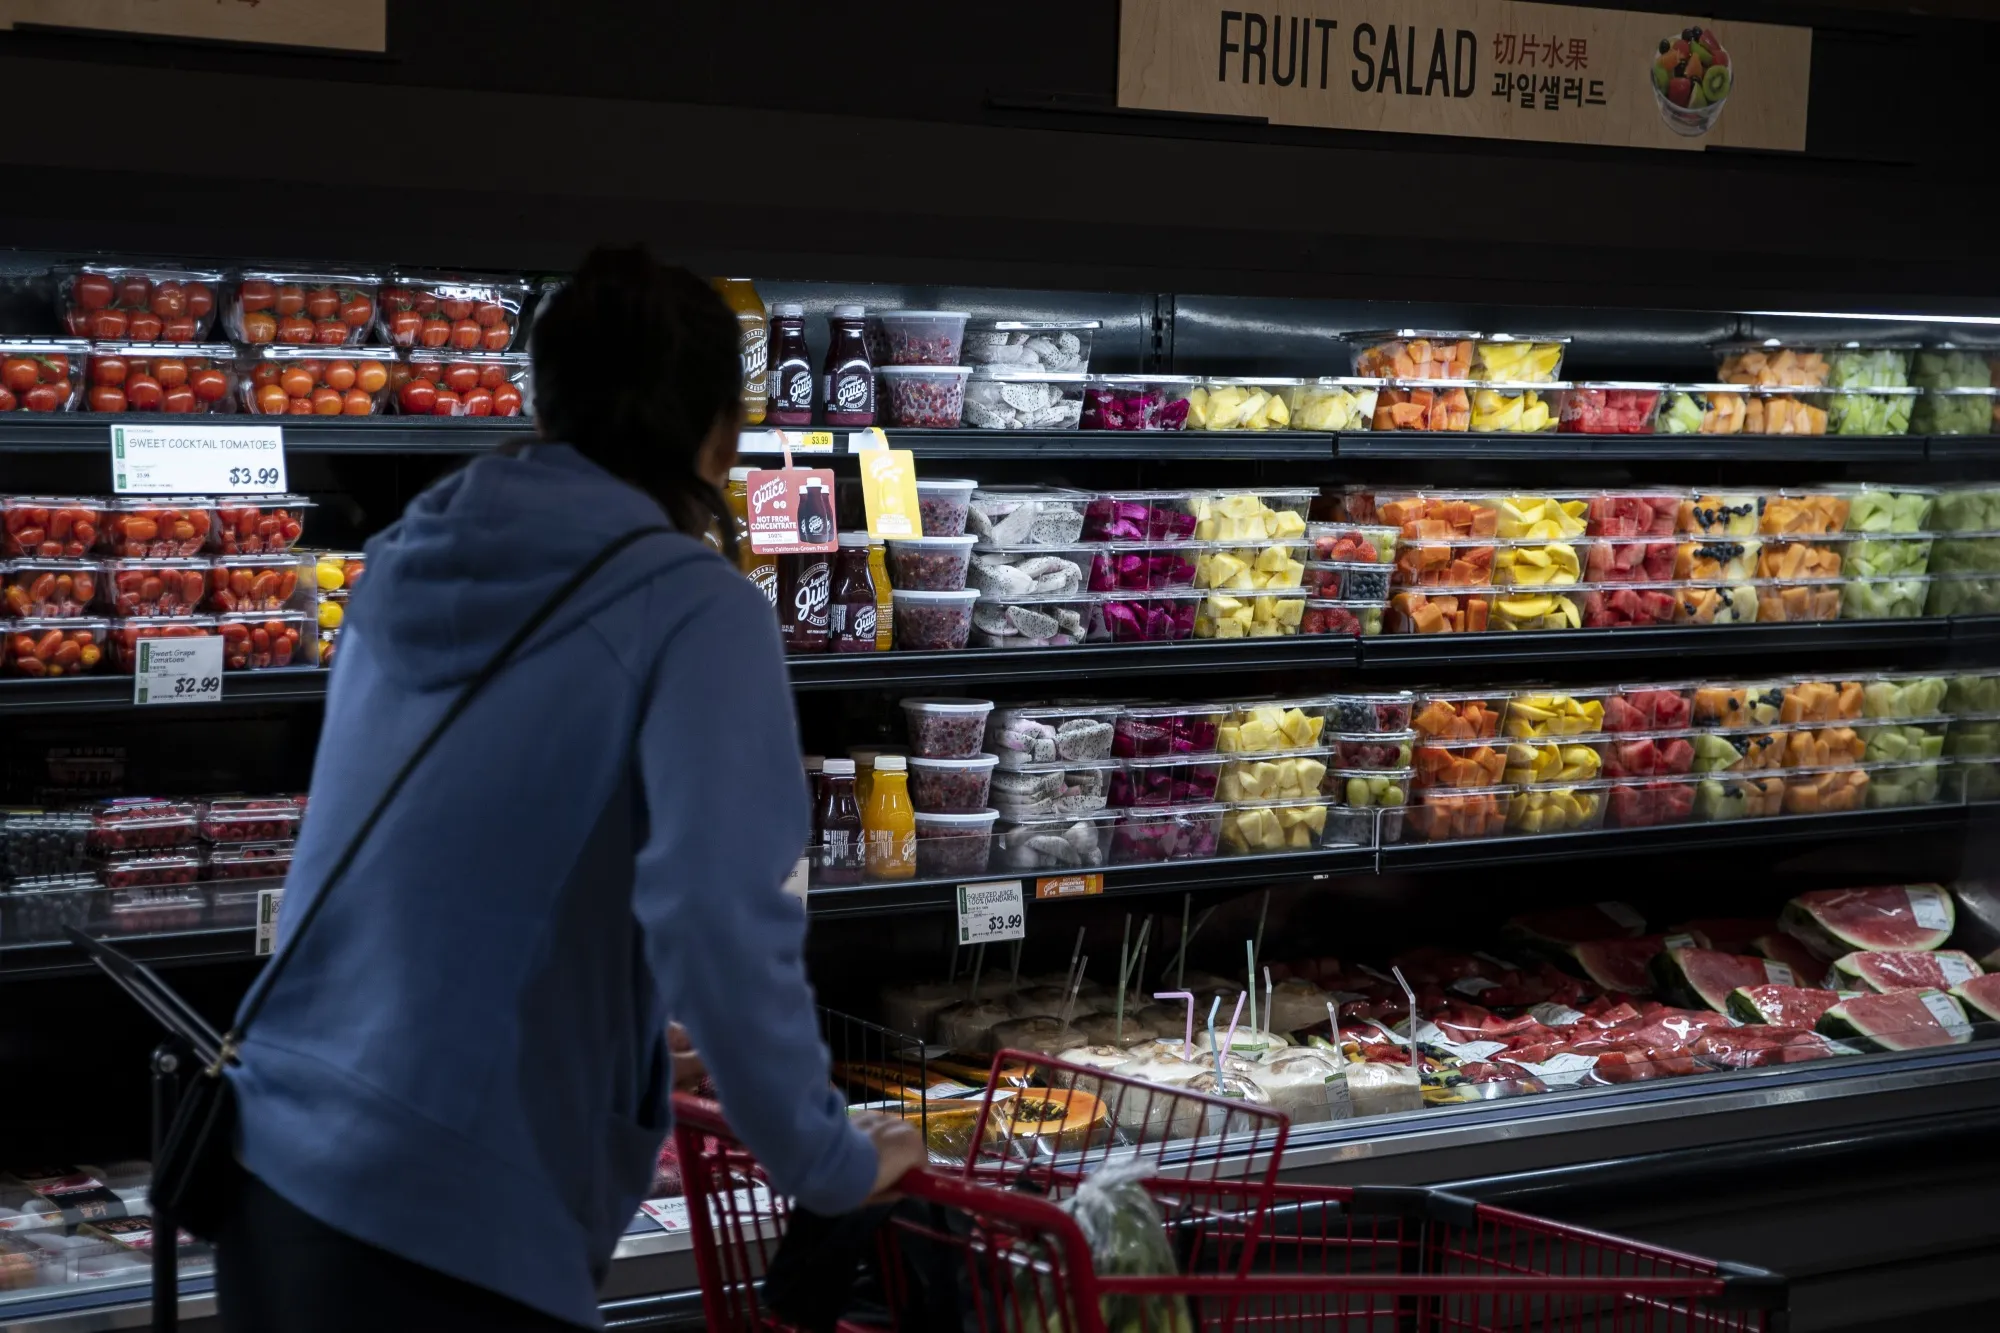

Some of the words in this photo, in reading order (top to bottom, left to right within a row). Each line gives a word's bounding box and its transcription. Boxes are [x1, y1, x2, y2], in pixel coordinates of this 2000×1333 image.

[1218, 10, 1338, 90] FRUIT
[1351, 22, 1478, 98] SALAD
[1492, 32, 1588, 71] 切片水果
[1491, 72, 1607, 111] 과일샐러드
[129, 438, 166, 449] SWEET
[168, 438, 218, 449] COCKTAIL
[220, 440, 277, 450] TOMATOES
[811, 436, 829, 445] $3.99
[229, 467, 279, 486] $3.99
[750, 522, 797, 530] CONCENTRATE
[174, 649, 196, 658] Grape
[149, 656, 185, 664] Tomatoes
[174, 676, 220, 696] $2.99
[967, 890, 998, 900] SQUEEZED
[999, 889, 1014, 897] JUICE
[985, 894, 1019, 905] (MANDARIN)
[988, 914, 1022, 933] $3.99
